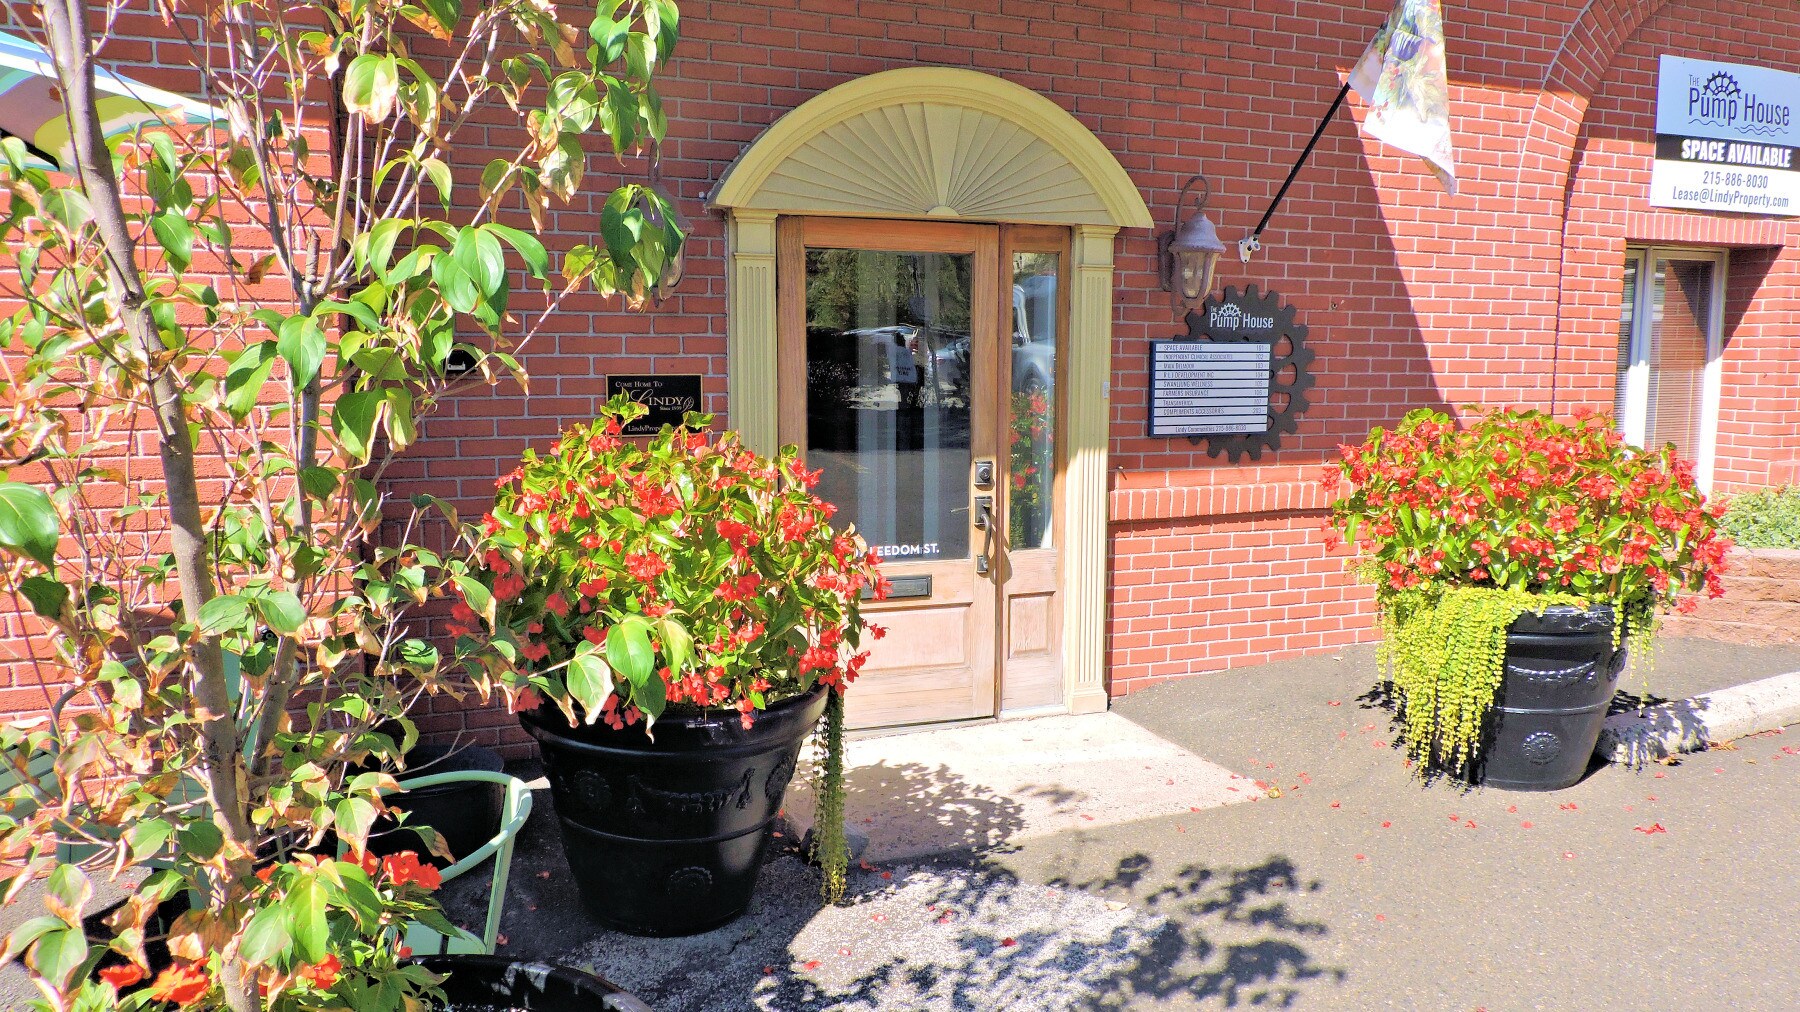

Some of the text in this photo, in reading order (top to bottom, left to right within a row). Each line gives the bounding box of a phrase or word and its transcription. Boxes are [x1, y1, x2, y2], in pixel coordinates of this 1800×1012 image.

[1689, 74, 1700, 86] THE
[1688, 87, 1790, 126] Pump House
[1681, 139, 1792, 168] SPACE AVAILABLE
[1703, 171, 1769, 188] 215-886-8030
[1672, 186, 1789, 208] Lease@LindyProperty.com
[1210, 312, 1274, 331] Pump House
[630, 388, 684, 406] LINDY
[866, 545, 920, 557] EEDOM
[923, 543, 940, 554] ST.
